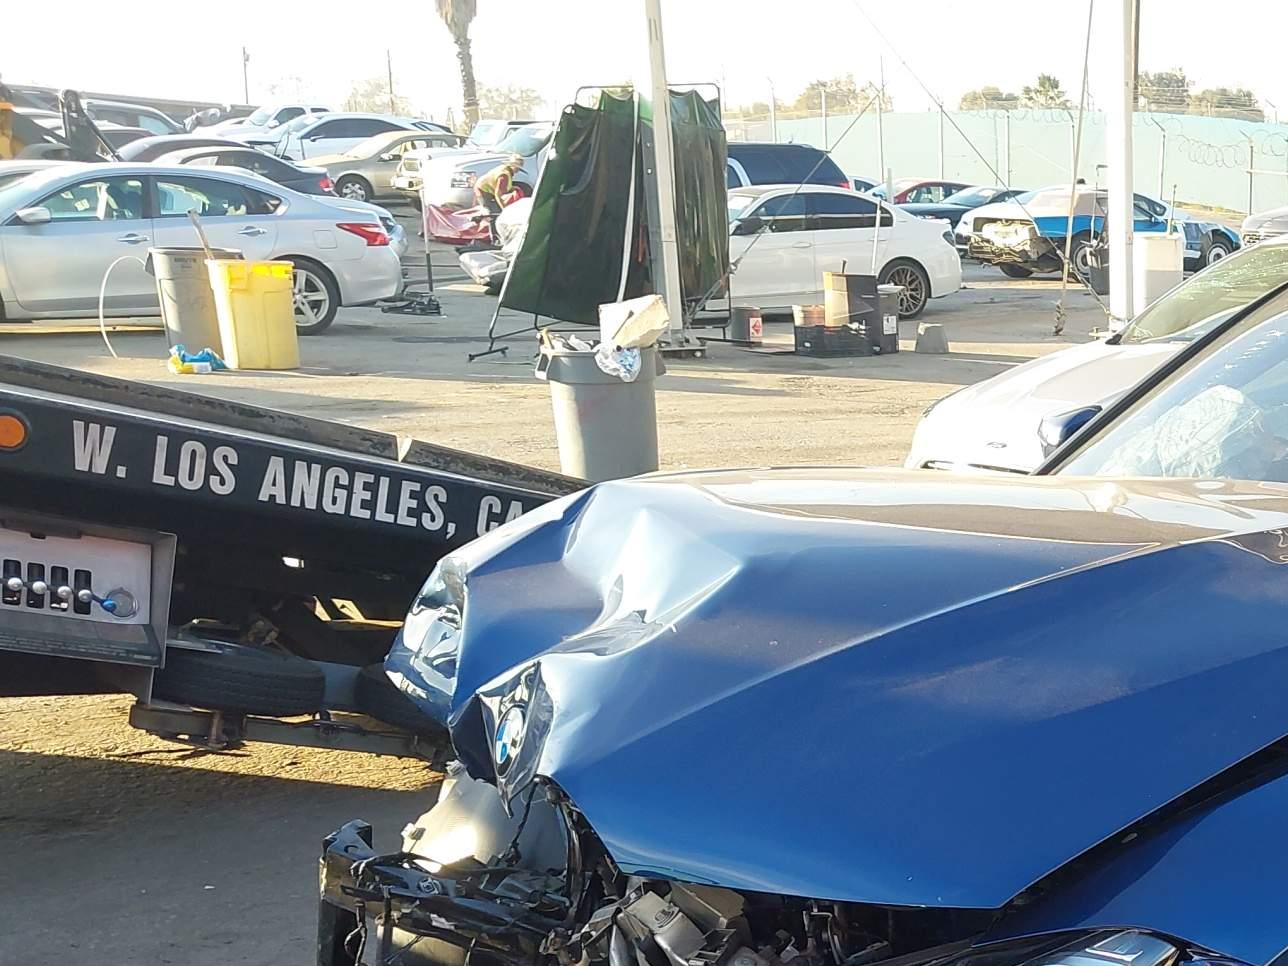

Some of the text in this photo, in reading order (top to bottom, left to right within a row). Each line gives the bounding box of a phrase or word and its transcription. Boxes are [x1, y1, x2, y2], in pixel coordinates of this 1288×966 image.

[72, 419, 127, 479] W.
[151, 434, 239, 495] LOS
[257, 455, 457, 540] ANGELES,
